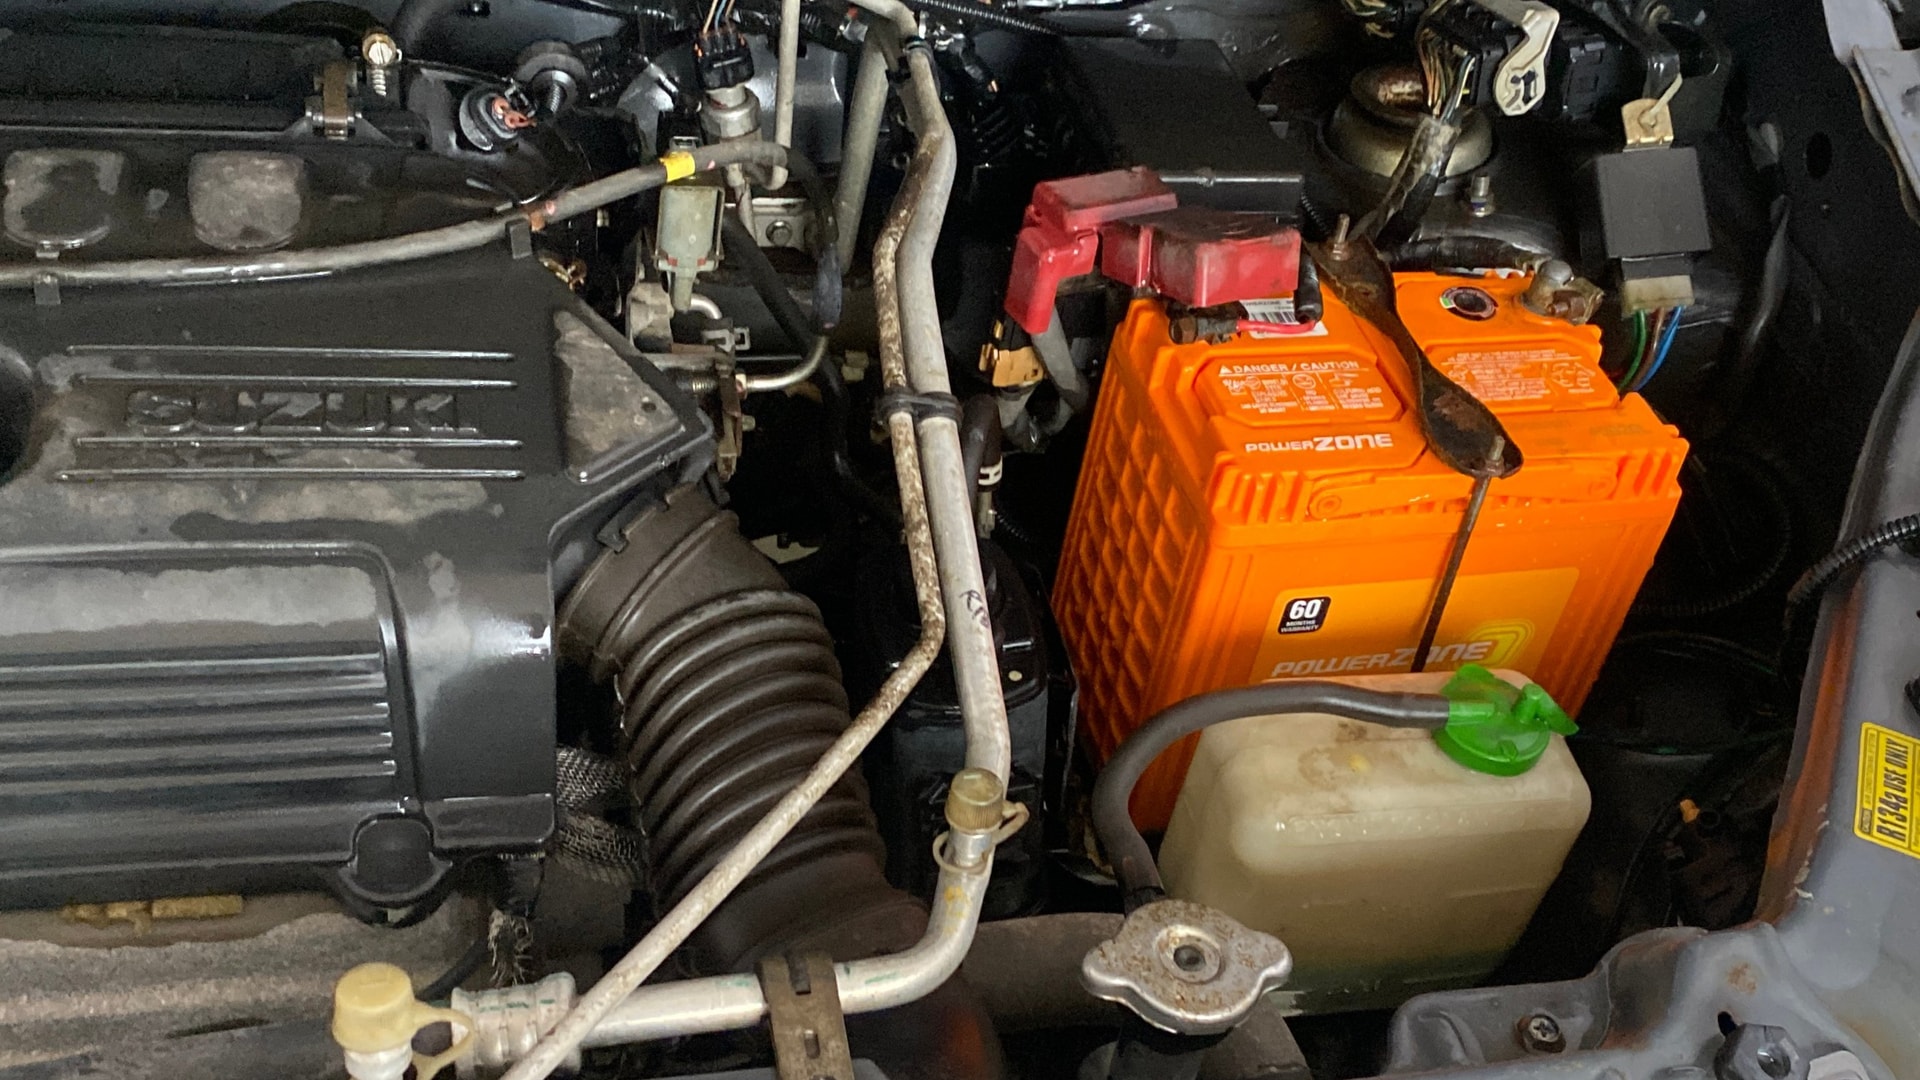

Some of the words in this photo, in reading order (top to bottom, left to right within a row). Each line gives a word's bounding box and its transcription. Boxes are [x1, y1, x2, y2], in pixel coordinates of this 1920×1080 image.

[1232, 363, 1289, 374] DANGER
[1300, 360, 1360, 371] CAUTION
[126, 390, 480, 434] SUZUKI
[1245, 433, 1394, 453] POWERZONE
[1289, 599, 1321, 620] 60
[1280, 624, 1320, 633] WARRANTY
[1885, 737, 1909, 769] ONLY
[1883, 767, 1907, 793] USE
[1876, 791, 1908, 843] R134a
